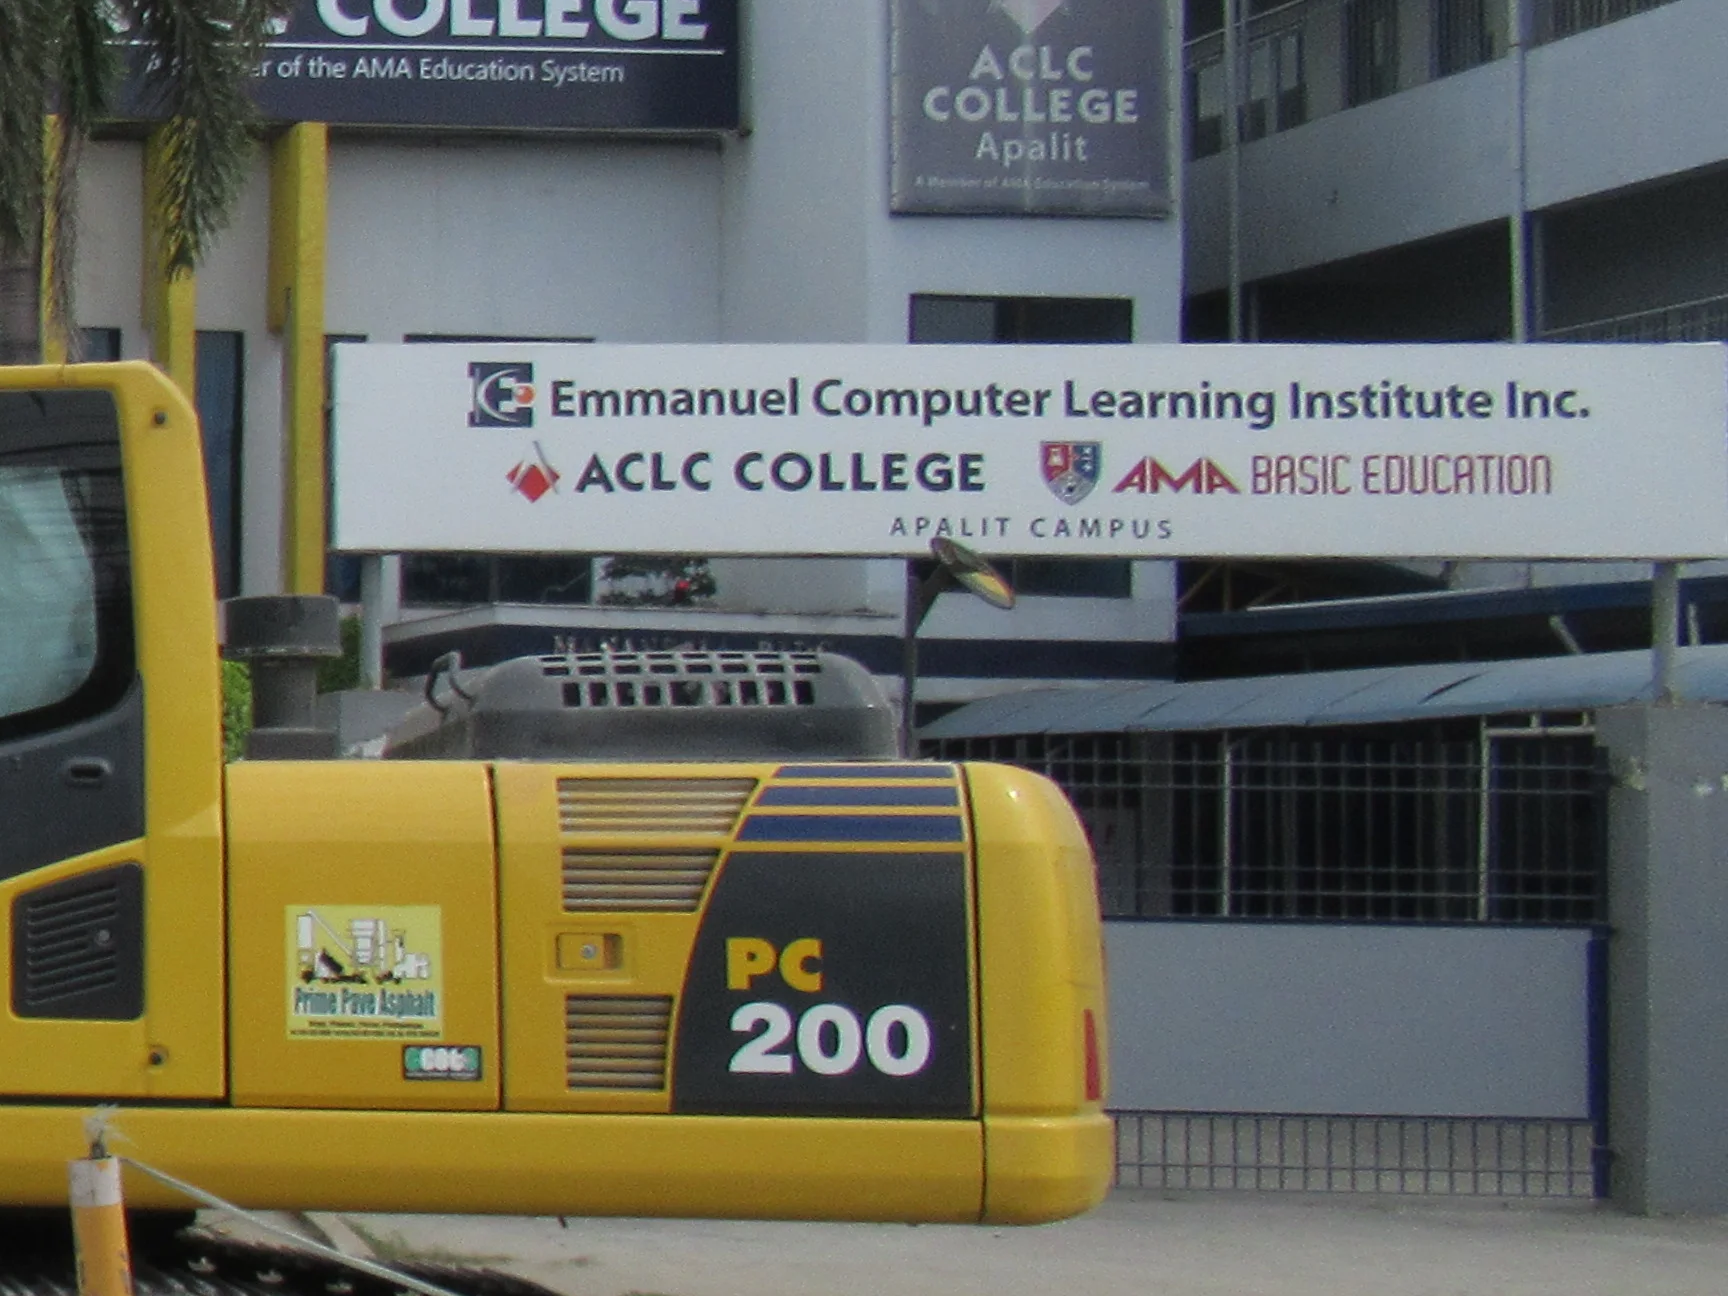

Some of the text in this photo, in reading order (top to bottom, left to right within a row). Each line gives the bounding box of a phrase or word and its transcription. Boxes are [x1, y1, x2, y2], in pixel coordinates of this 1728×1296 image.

[277, 55, 303, 79] of
[307, 56, 345, 80] the
[352, 58, 412, 81] AMA
[420, 57, 535, 82] Education
[541, 61, 624, 87] System
[969, 44, 1093, 82] ACLC
[922, 85, 1139, 124] COLLEGE
[975, 132, 1088, 167] Apalit
[551, 377, 1591, 430] Emmanuel Computer Learning Institute Inc.
[575, 451, 1553, 496] ACLC COLLEGE AMA BASIC EDUCATION
[890, 516, 1173, 539] APALIT CAMPUS
[725, 937, 824, 993] PC
[294, 987, 435, 1018] Prime Pave Asphalt
[728, 1001, 932, 1077] 200
